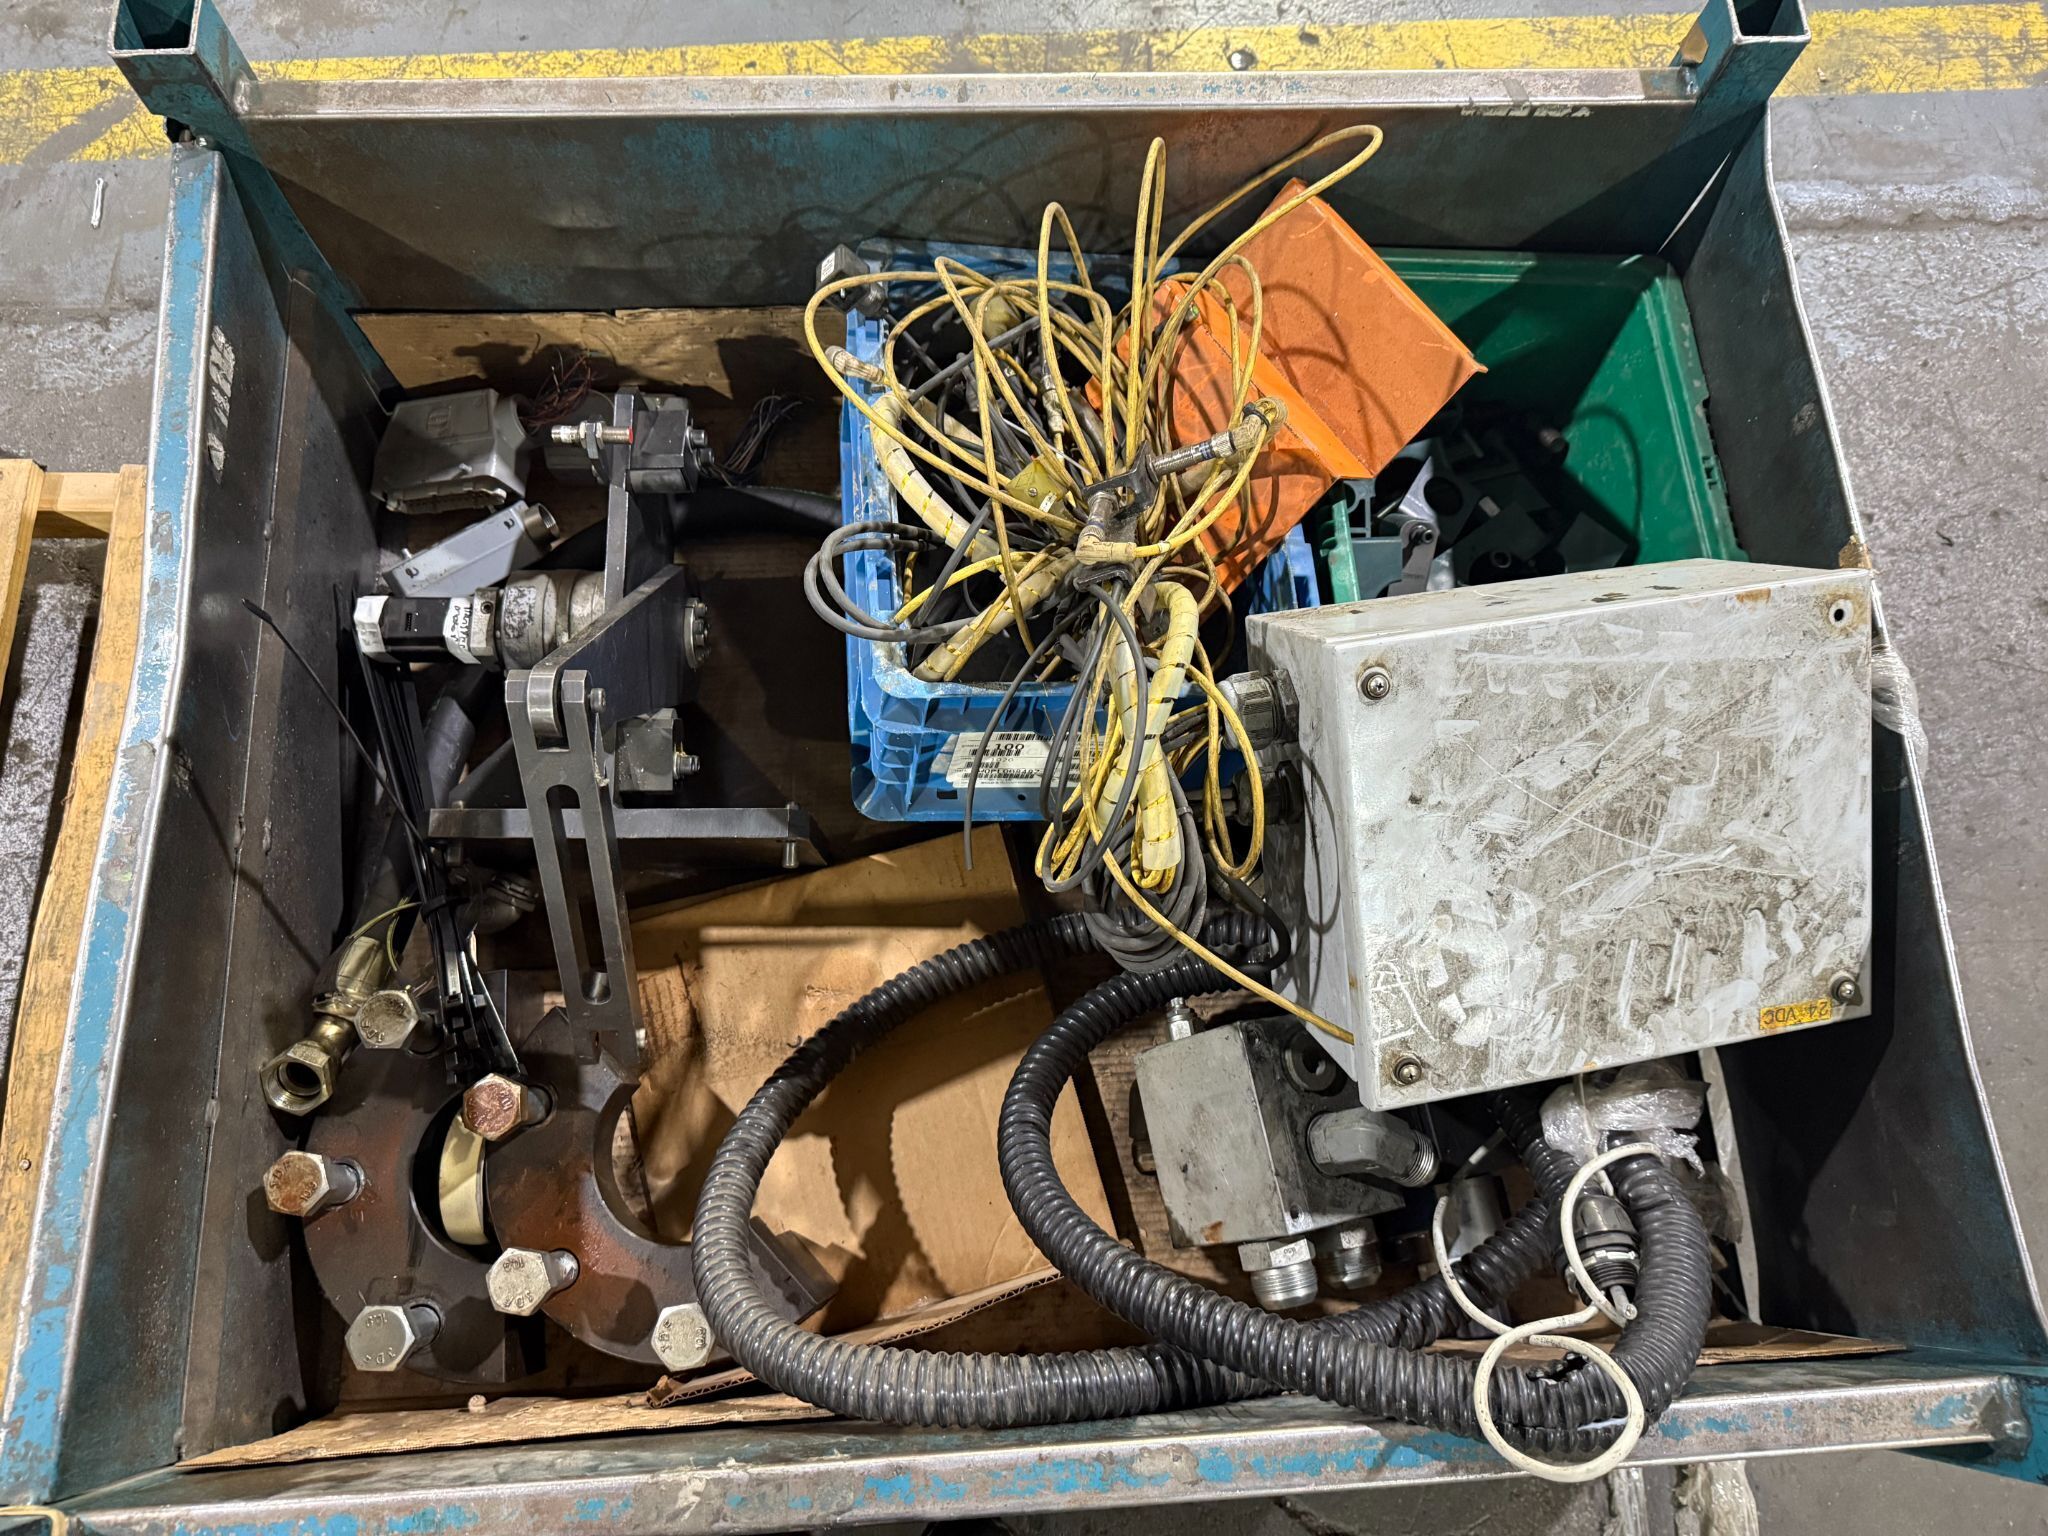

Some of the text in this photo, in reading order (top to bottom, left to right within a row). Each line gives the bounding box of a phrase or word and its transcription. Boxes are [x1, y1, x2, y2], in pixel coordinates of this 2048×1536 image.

[995, 743, 1025, 751] 100
[1763, 1001, 1829, 1024] 24 VDC
